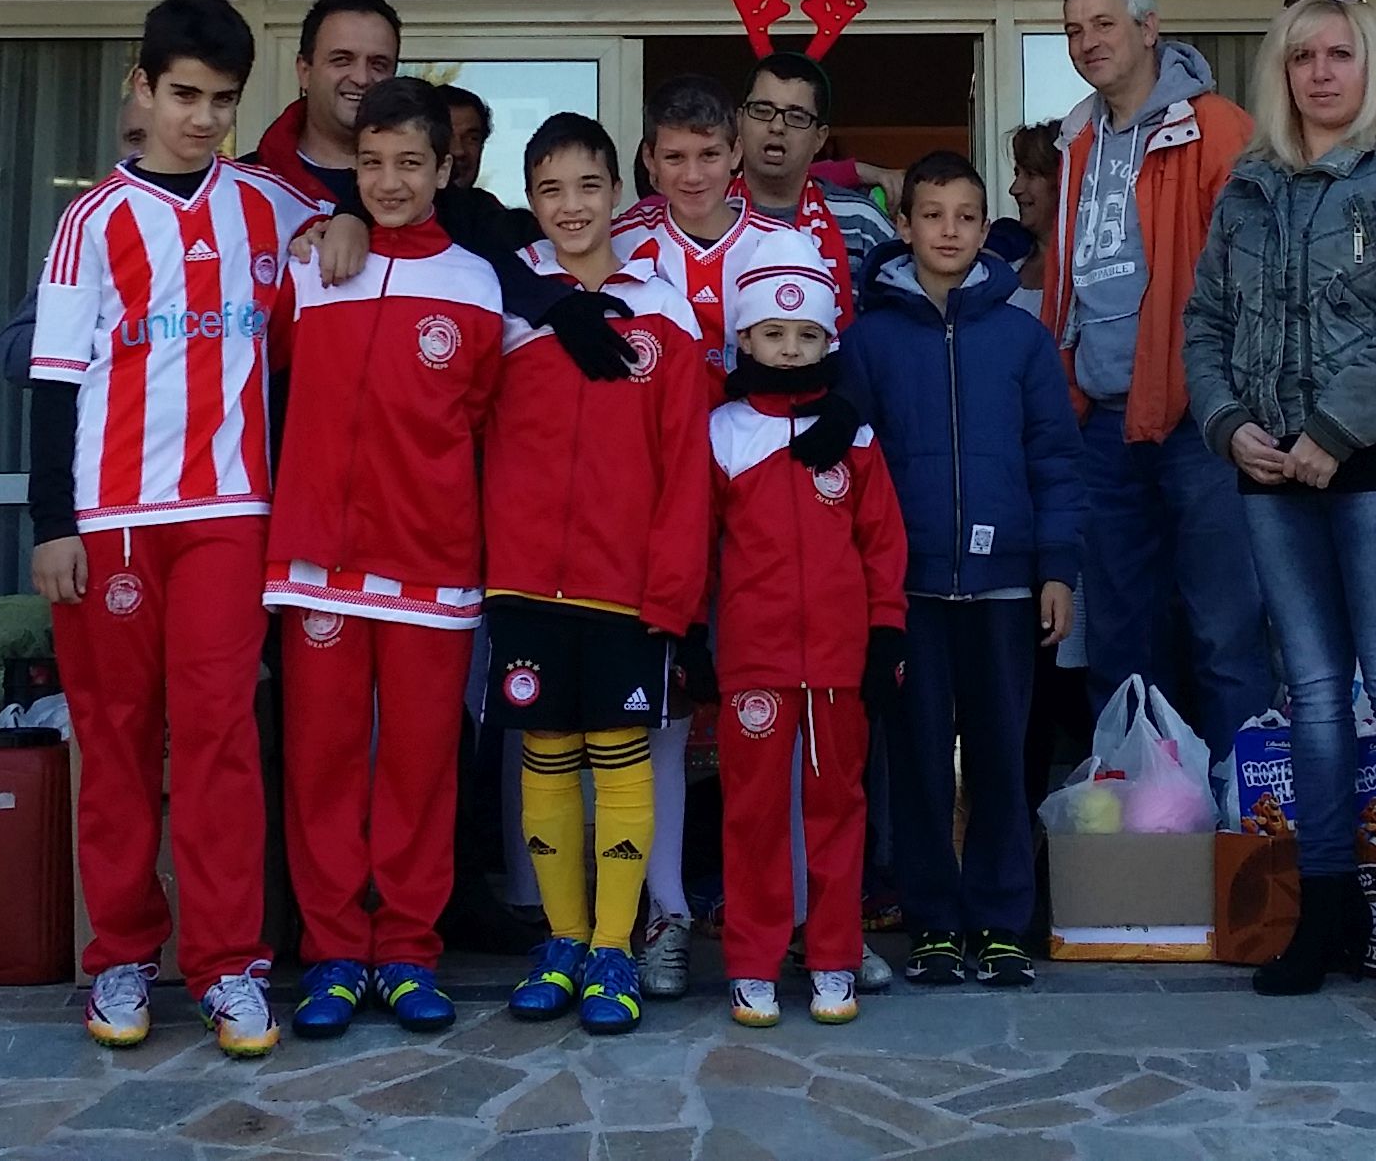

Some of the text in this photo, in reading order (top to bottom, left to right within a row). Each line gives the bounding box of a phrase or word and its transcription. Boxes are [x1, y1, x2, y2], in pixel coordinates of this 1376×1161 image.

[121, 301, 233, 347] unicef
[623, 701, 650, 711] adidas
[1242, 757, 1293, 788] FROSTE
